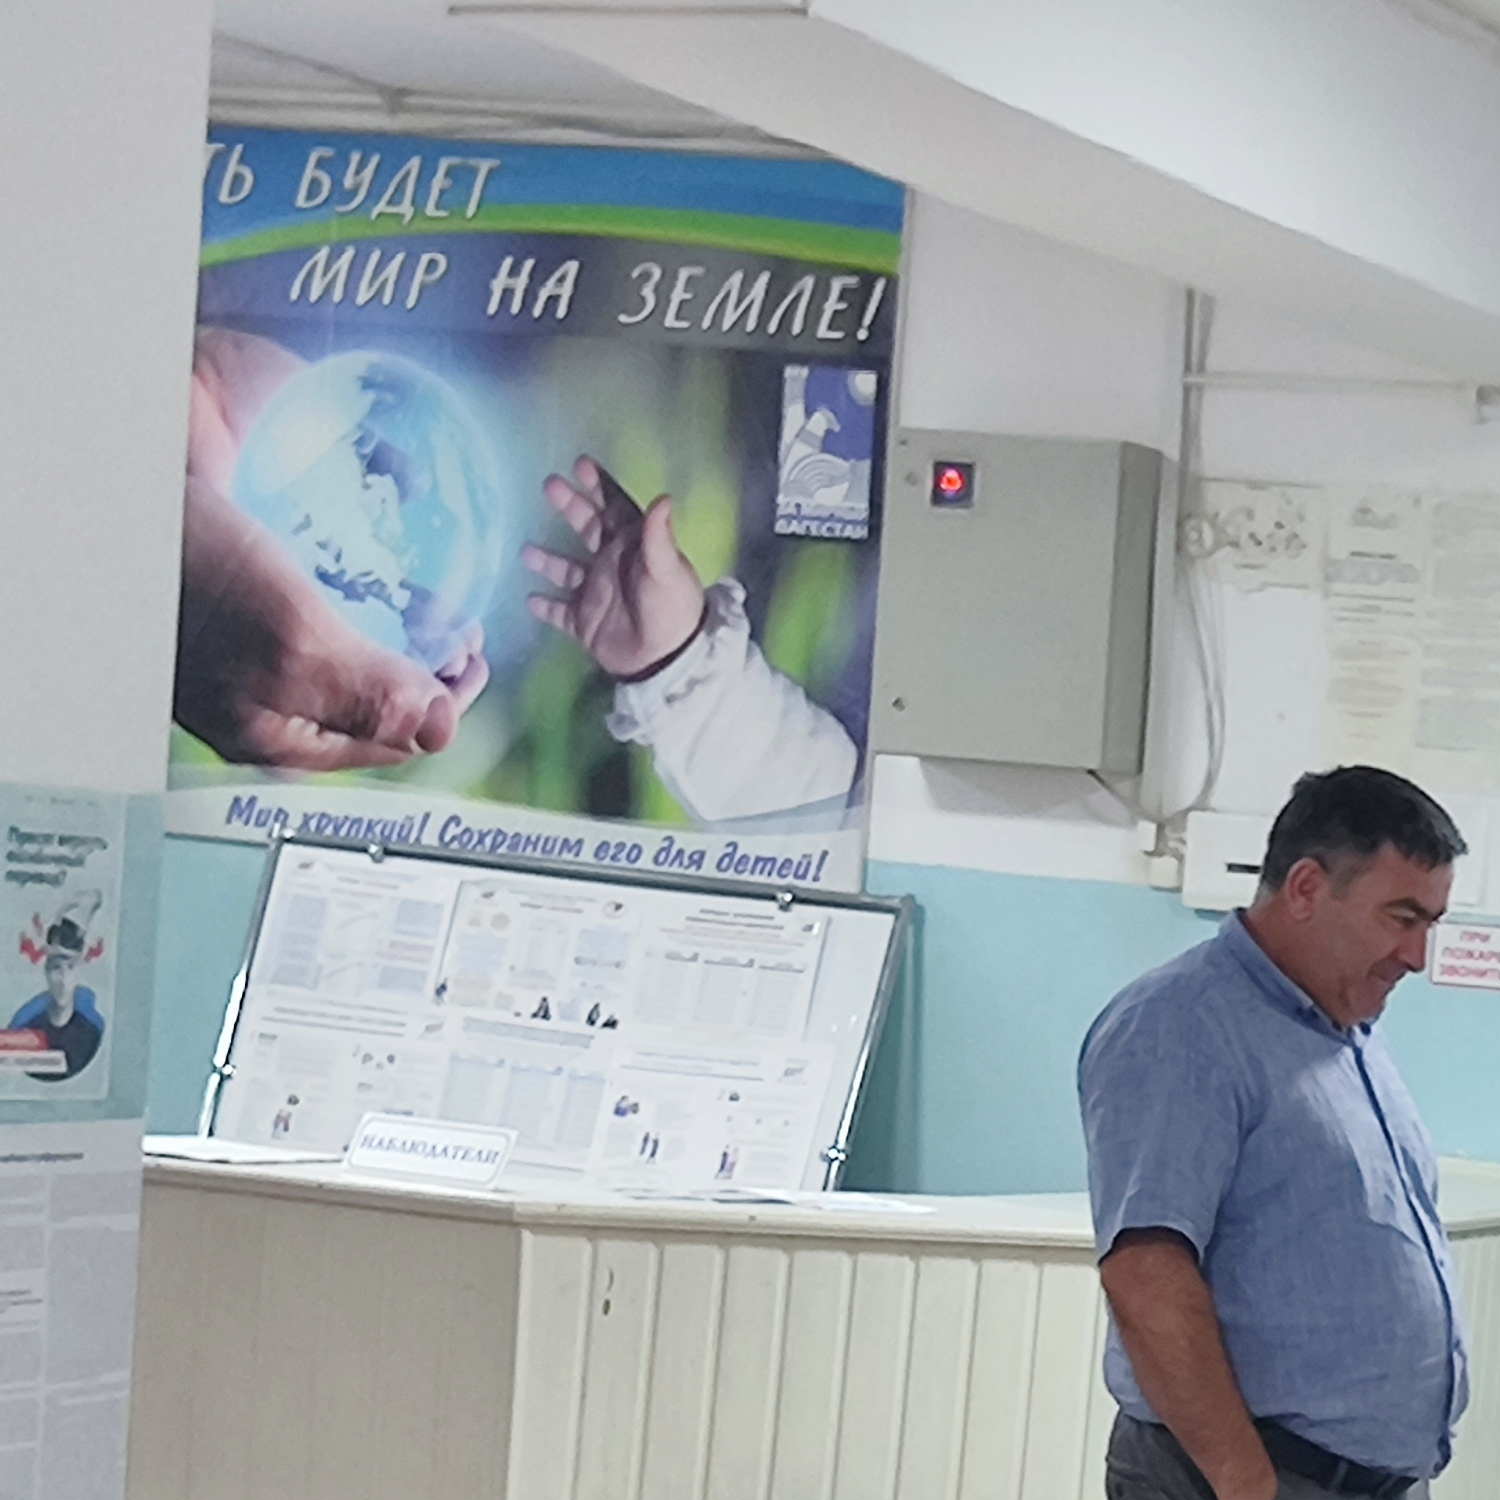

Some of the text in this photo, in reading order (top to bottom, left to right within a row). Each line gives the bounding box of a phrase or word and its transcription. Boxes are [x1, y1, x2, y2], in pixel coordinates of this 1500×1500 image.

[294, 146, 501, 225] БУДЕТ
[289, 245, 887, 342] МИР НА ЗЕМЛЕ!
[225, 795, 290, 830] Мир
[438, 814, 585, 859] Сохраним
[593, 839, 643, 866] его
[652, 835, 708, 871] для
[716, 841, 829, 882] детей!
